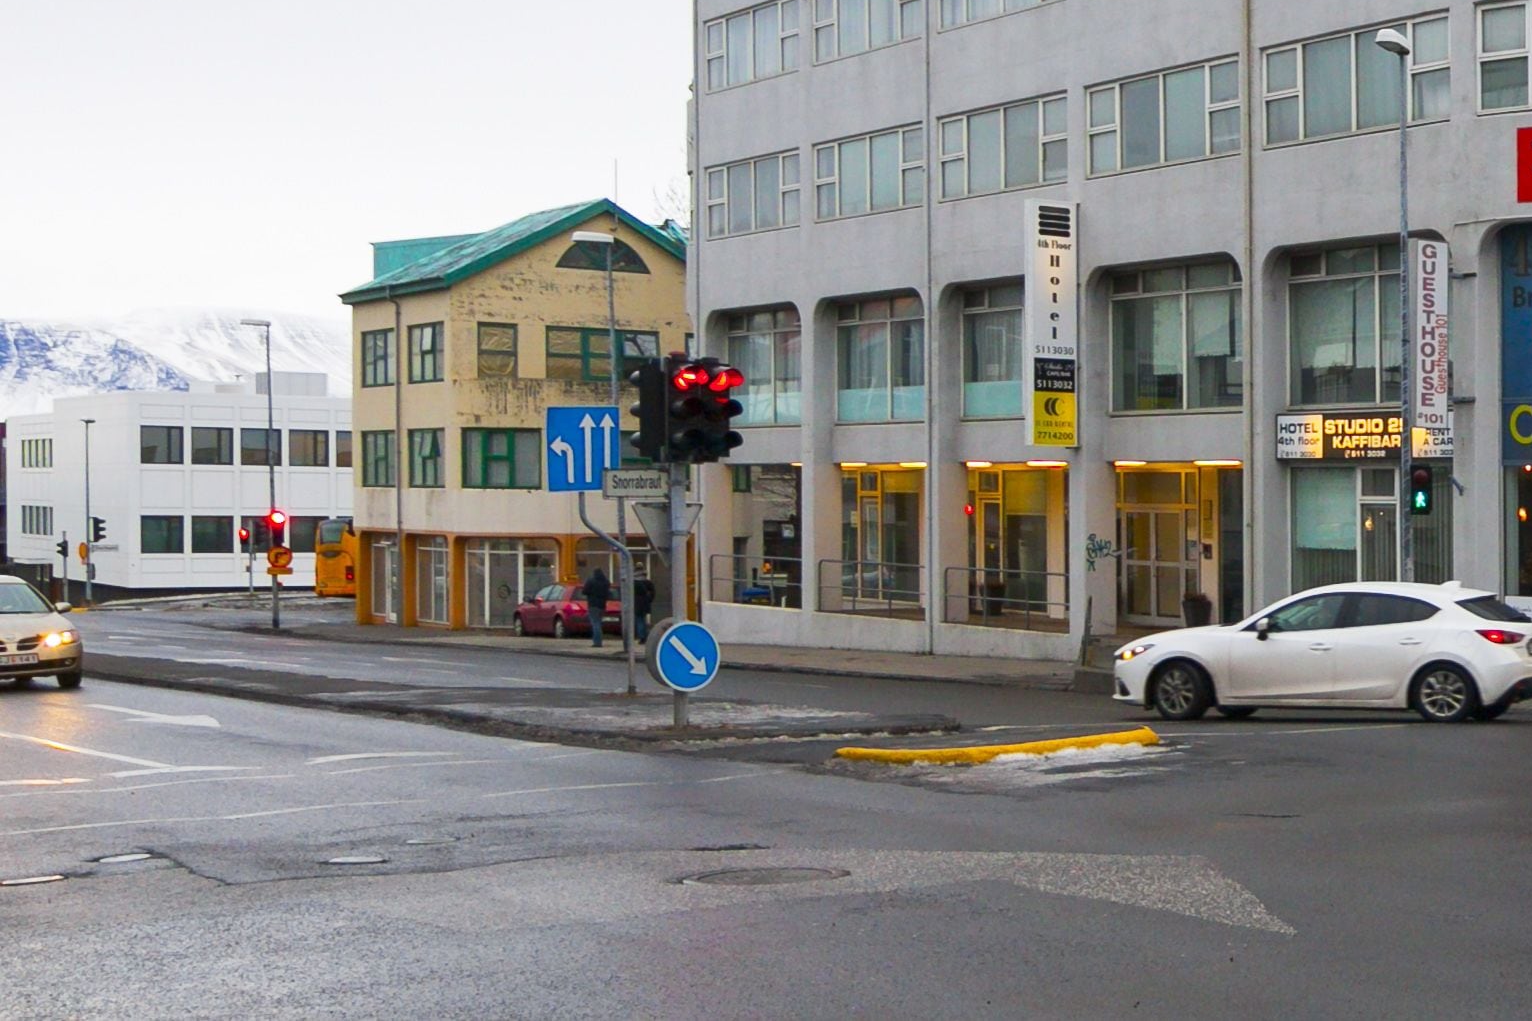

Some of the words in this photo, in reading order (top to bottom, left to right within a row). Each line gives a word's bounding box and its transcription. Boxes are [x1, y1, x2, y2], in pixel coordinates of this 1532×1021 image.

[1051, 239, 1071, 251] Floor
[1049, 255, 1060, 339] Hotel
[1420, 243, 1438, 408] GUESTHOUSE
[1035, 345, 1074, 356] 5113030
[1434, 332, 1447, 394] Guesthouse
[1036, 379, 1073, 390] 5113032
[1279, 423, 1318, 434] HOTEL
[1324, 418, 1384, 434] STUDIO
[1278, 437, 1295, 446] 4th
[1298, 436, 1319, 446] floor
[1332, 435, 1401, 449] KAFFIBAR
[1432, 437, 1453, 446] CAR
[612, 474, 662, 489] Snorrabraut
